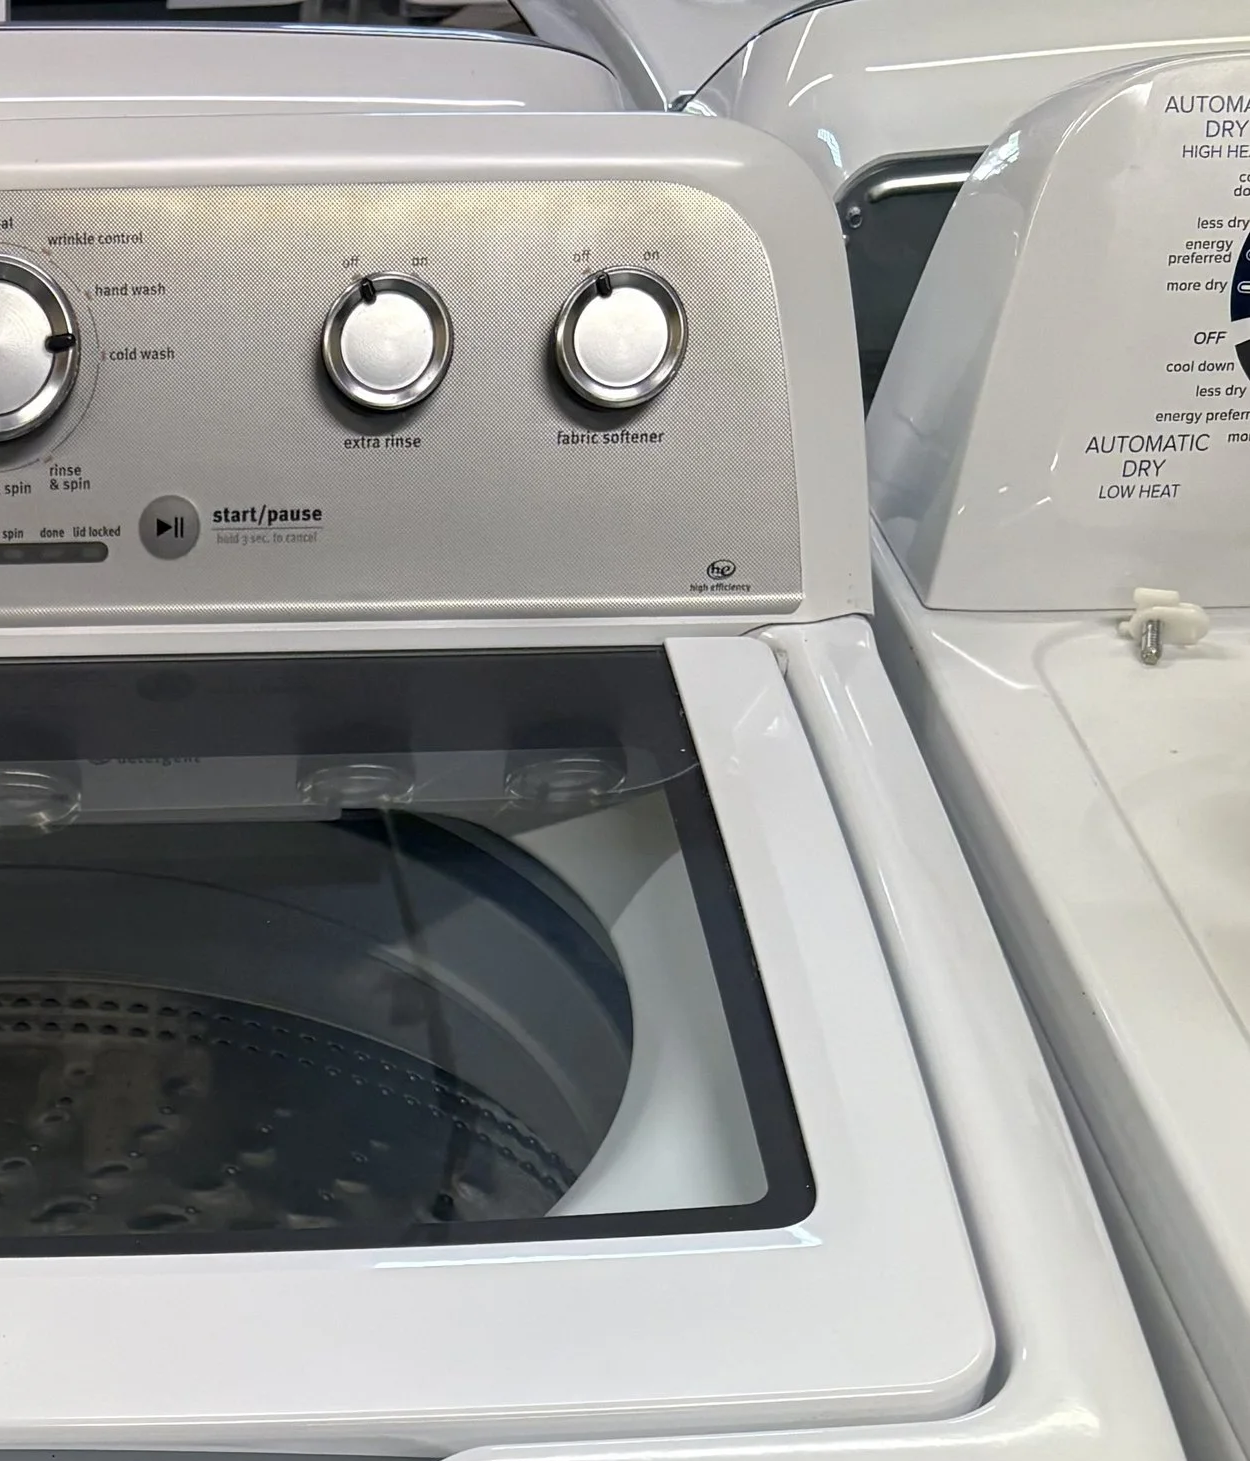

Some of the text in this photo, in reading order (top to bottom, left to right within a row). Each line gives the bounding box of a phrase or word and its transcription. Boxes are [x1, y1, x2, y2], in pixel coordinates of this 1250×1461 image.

[1205, 120, 1249, 138] DRY
[1182, 144, 1250, 159] HIGH HE
[1197, 216, 1250, 231] less dry
[47, 232, 144, 246] wrinkle control
[1185, 239, 1234, 252] energy
[342, 255, 359, 269] off
[412, 255, 429, 267] on
[573, 250, 591, 263] off
[643, 250, 661, 262] on
[1168, 252, 1233, 267] preferred
[95, 283, 167, 297] hand wash
[1166, 278, 1229, 294] more dry
[1193, 331, 1228, 345] OFF
[109, 346, 176, 362] cold wash
[1166, 360, 1236, 373] cool down
[1195, 384, 1247, 399] less dry
[1155, 411, 1202, 424] energy
[343, 433, 422, 450] extra rinse
[556, 430, 665, 446] fabric softener
[1085, 433, 1211, 454] AUTOMATIC
[1228, 433, 1250, 443] mo
[49, 465, 82, 478] rinse
[1122, 459, 1167, 478] DRY
[4, 482, 32, 497] spin
[49, 477, 91, 491] & spin
[1098, 483, 1181, 500] LOW HEAT
[212, 504, 323, 526] start/pause
[2, 526, 24, 541] spin
[40, 525, 65, 538] done
[73, 524, 121, 538] lid locked
[285, 531, 318, 543] cancel
[689, 583, 751, 593] high efficiency
